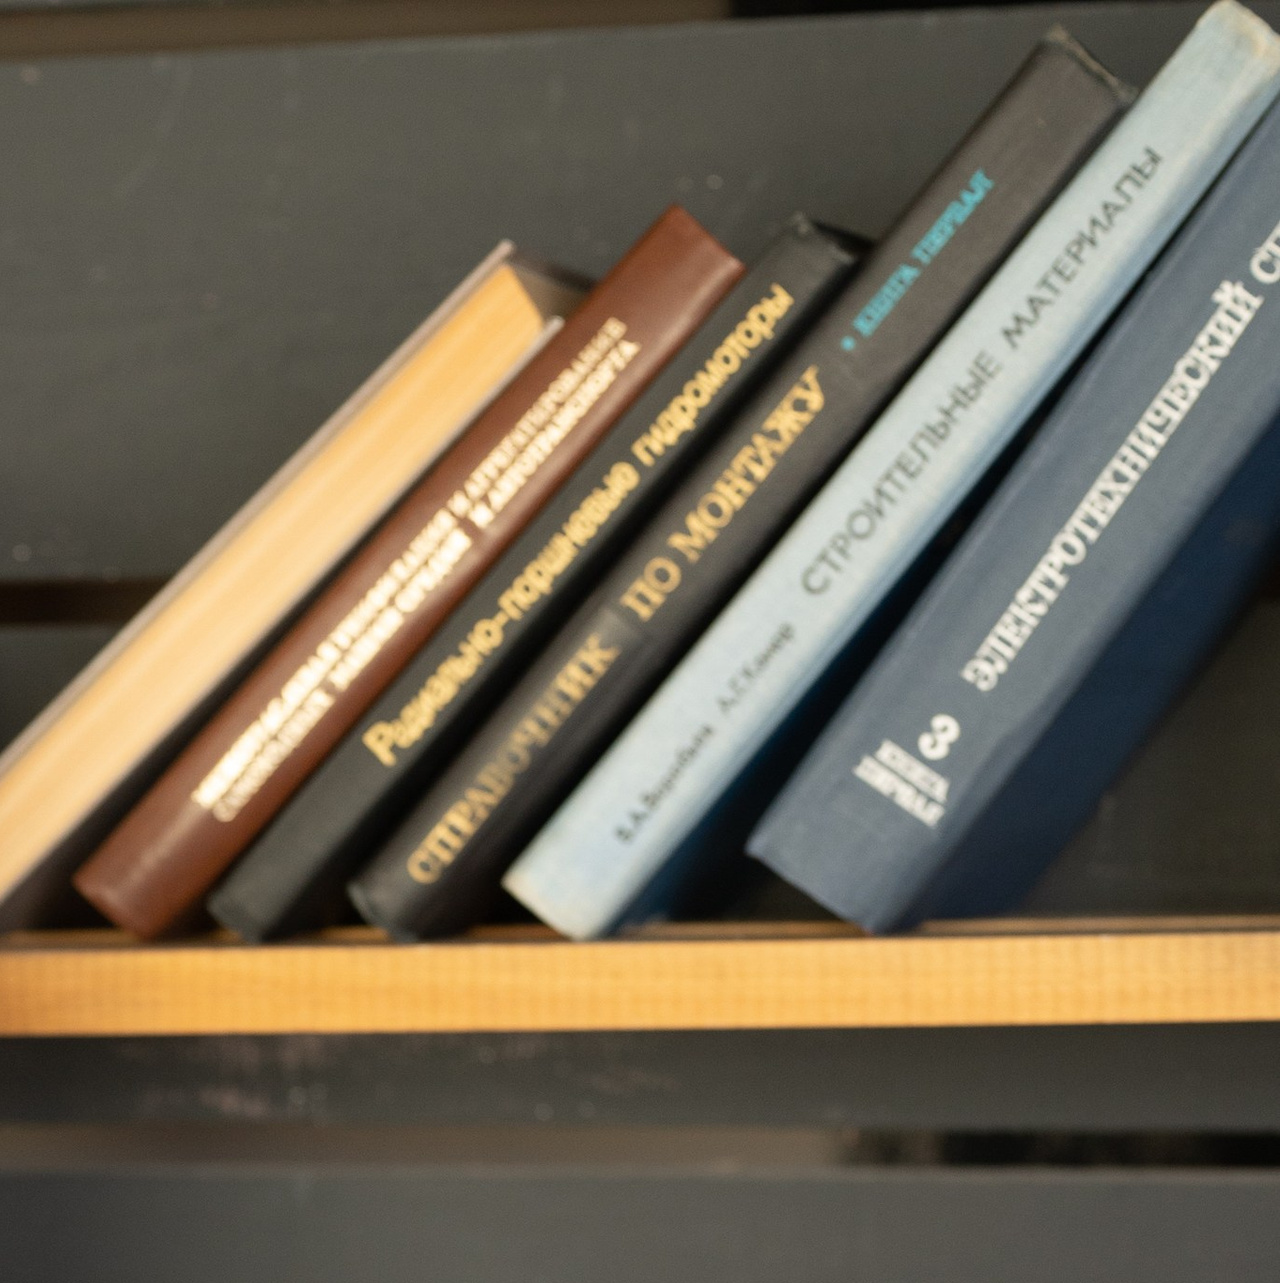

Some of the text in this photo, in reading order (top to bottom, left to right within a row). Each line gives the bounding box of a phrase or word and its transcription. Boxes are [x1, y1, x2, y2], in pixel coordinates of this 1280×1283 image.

[358, 455, 646, 770] Радиально-поршневые
[628, 281, 798, 471] гидромоторы
[795, 142, 1167, 602] СТРОИТЕЛЬНЫЕ МАТЕРИАЛЫ
[957, 272, 1266, 696] ЭЛЕКТРОТЕХНИЧЕСКИЙ
[399, 628, 622, 891] СПРАВОЧНИК
[616, 549, 688, 625] ПО
[665, 361, 841, 567] МОНТАЖУ
[911, 707, 966, 766] 3
